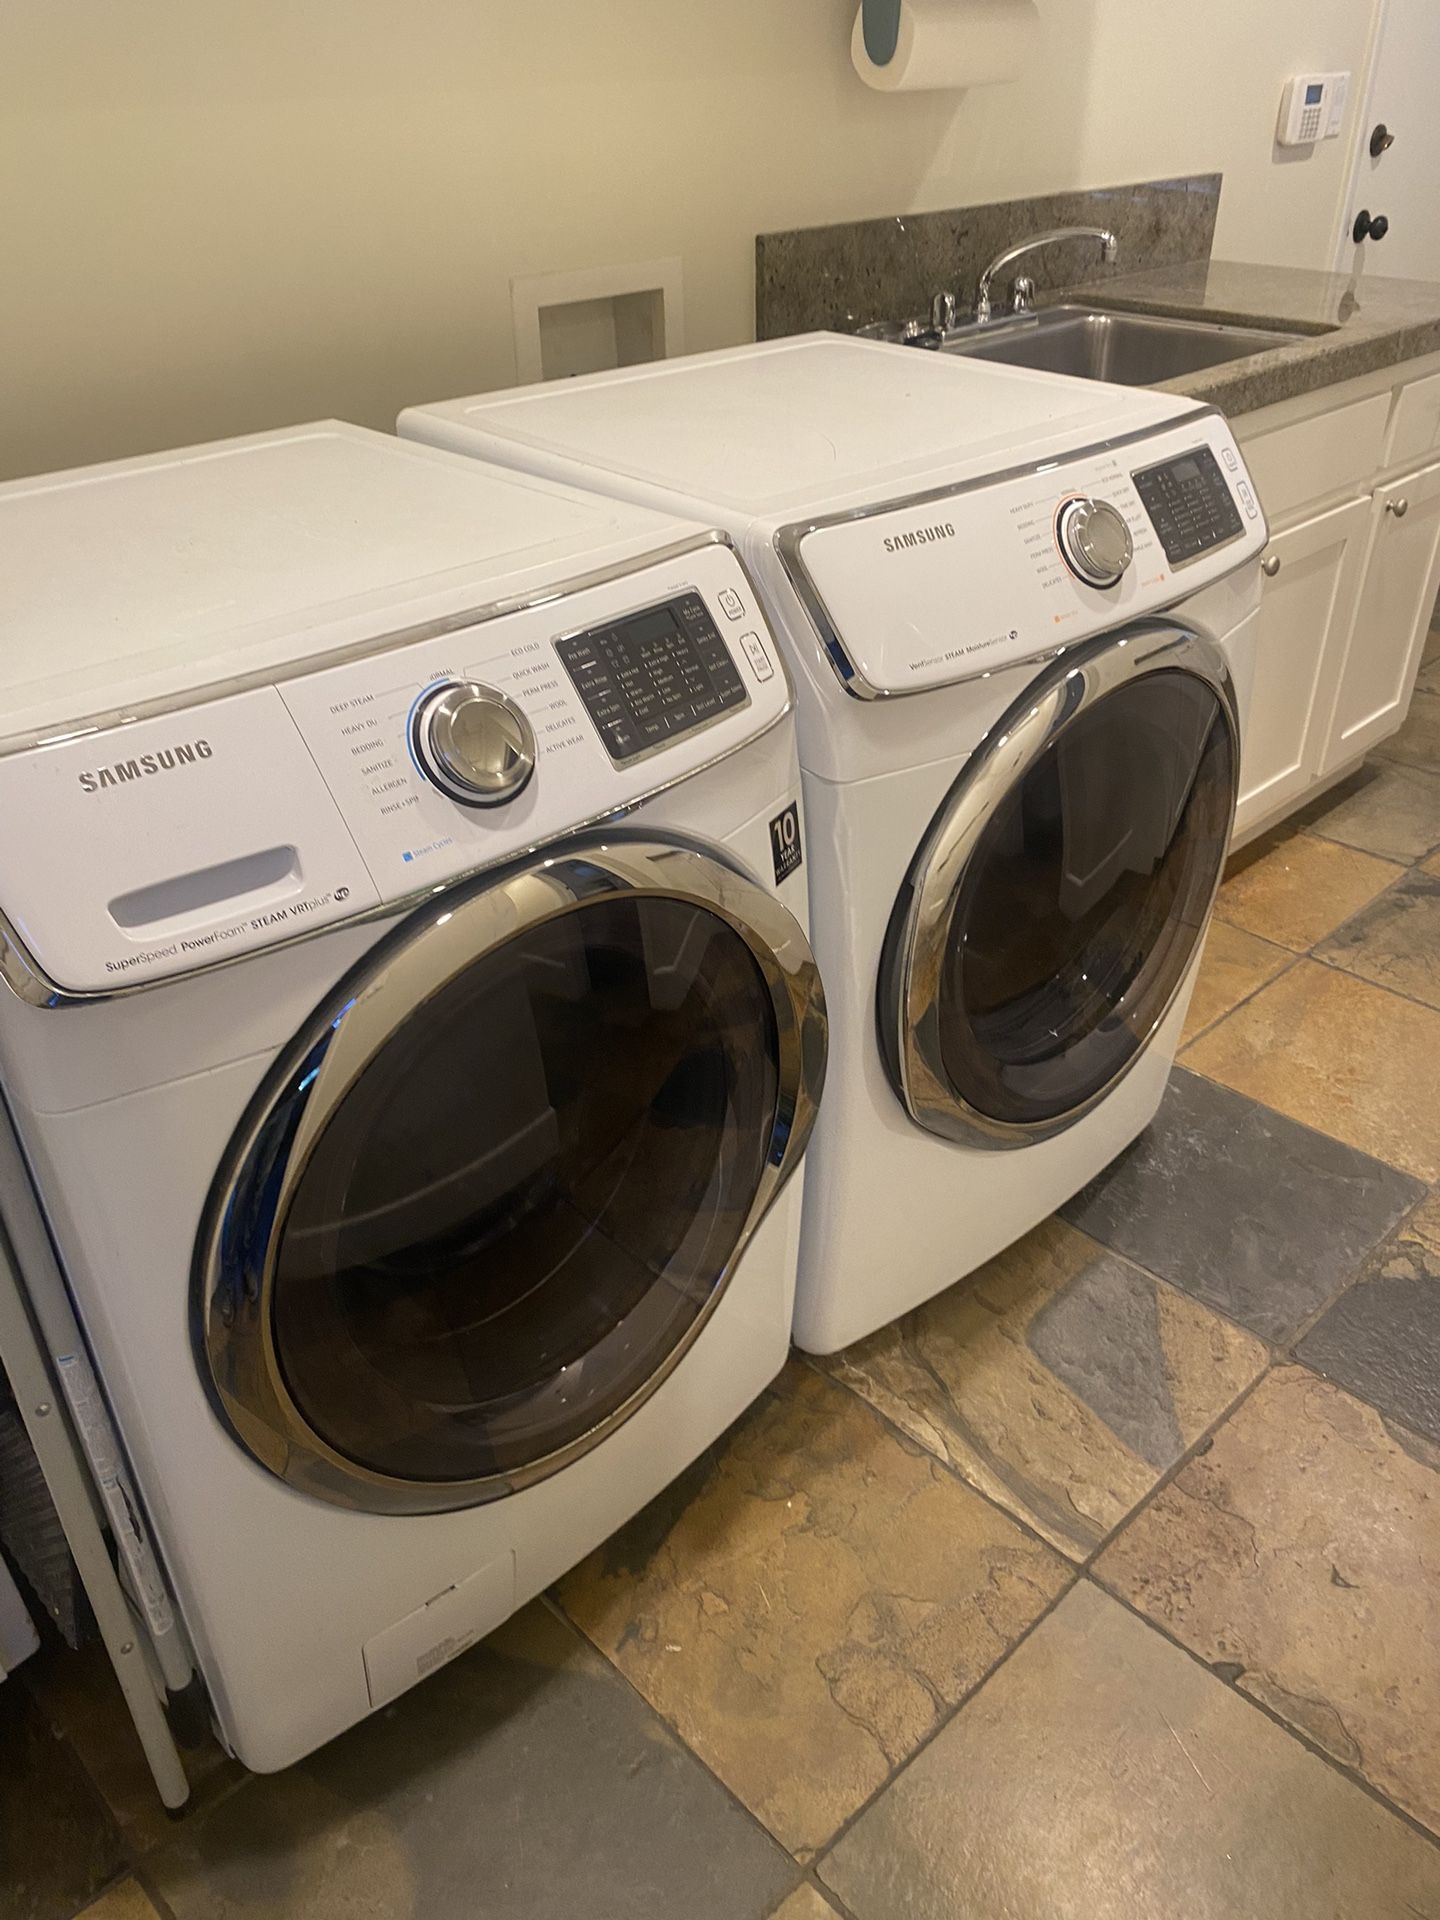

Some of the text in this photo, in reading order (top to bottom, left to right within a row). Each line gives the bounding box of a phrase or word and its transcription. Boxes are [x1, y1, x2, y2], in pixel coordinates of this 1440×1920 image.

[884, 523, 955, 553] SAMSUNG
[349, 694, 375, 708] STEAM
[351, 739, 384, 756] BEDDING
[79, 739, 214, 793] SAMSUNG
[361, 759, 393, 776] SANITIZE
[774, 811, 796, 853] 10
[105, 943, 179, 974] SuperSpeed
[250, 909, 289, 931] STEAM
